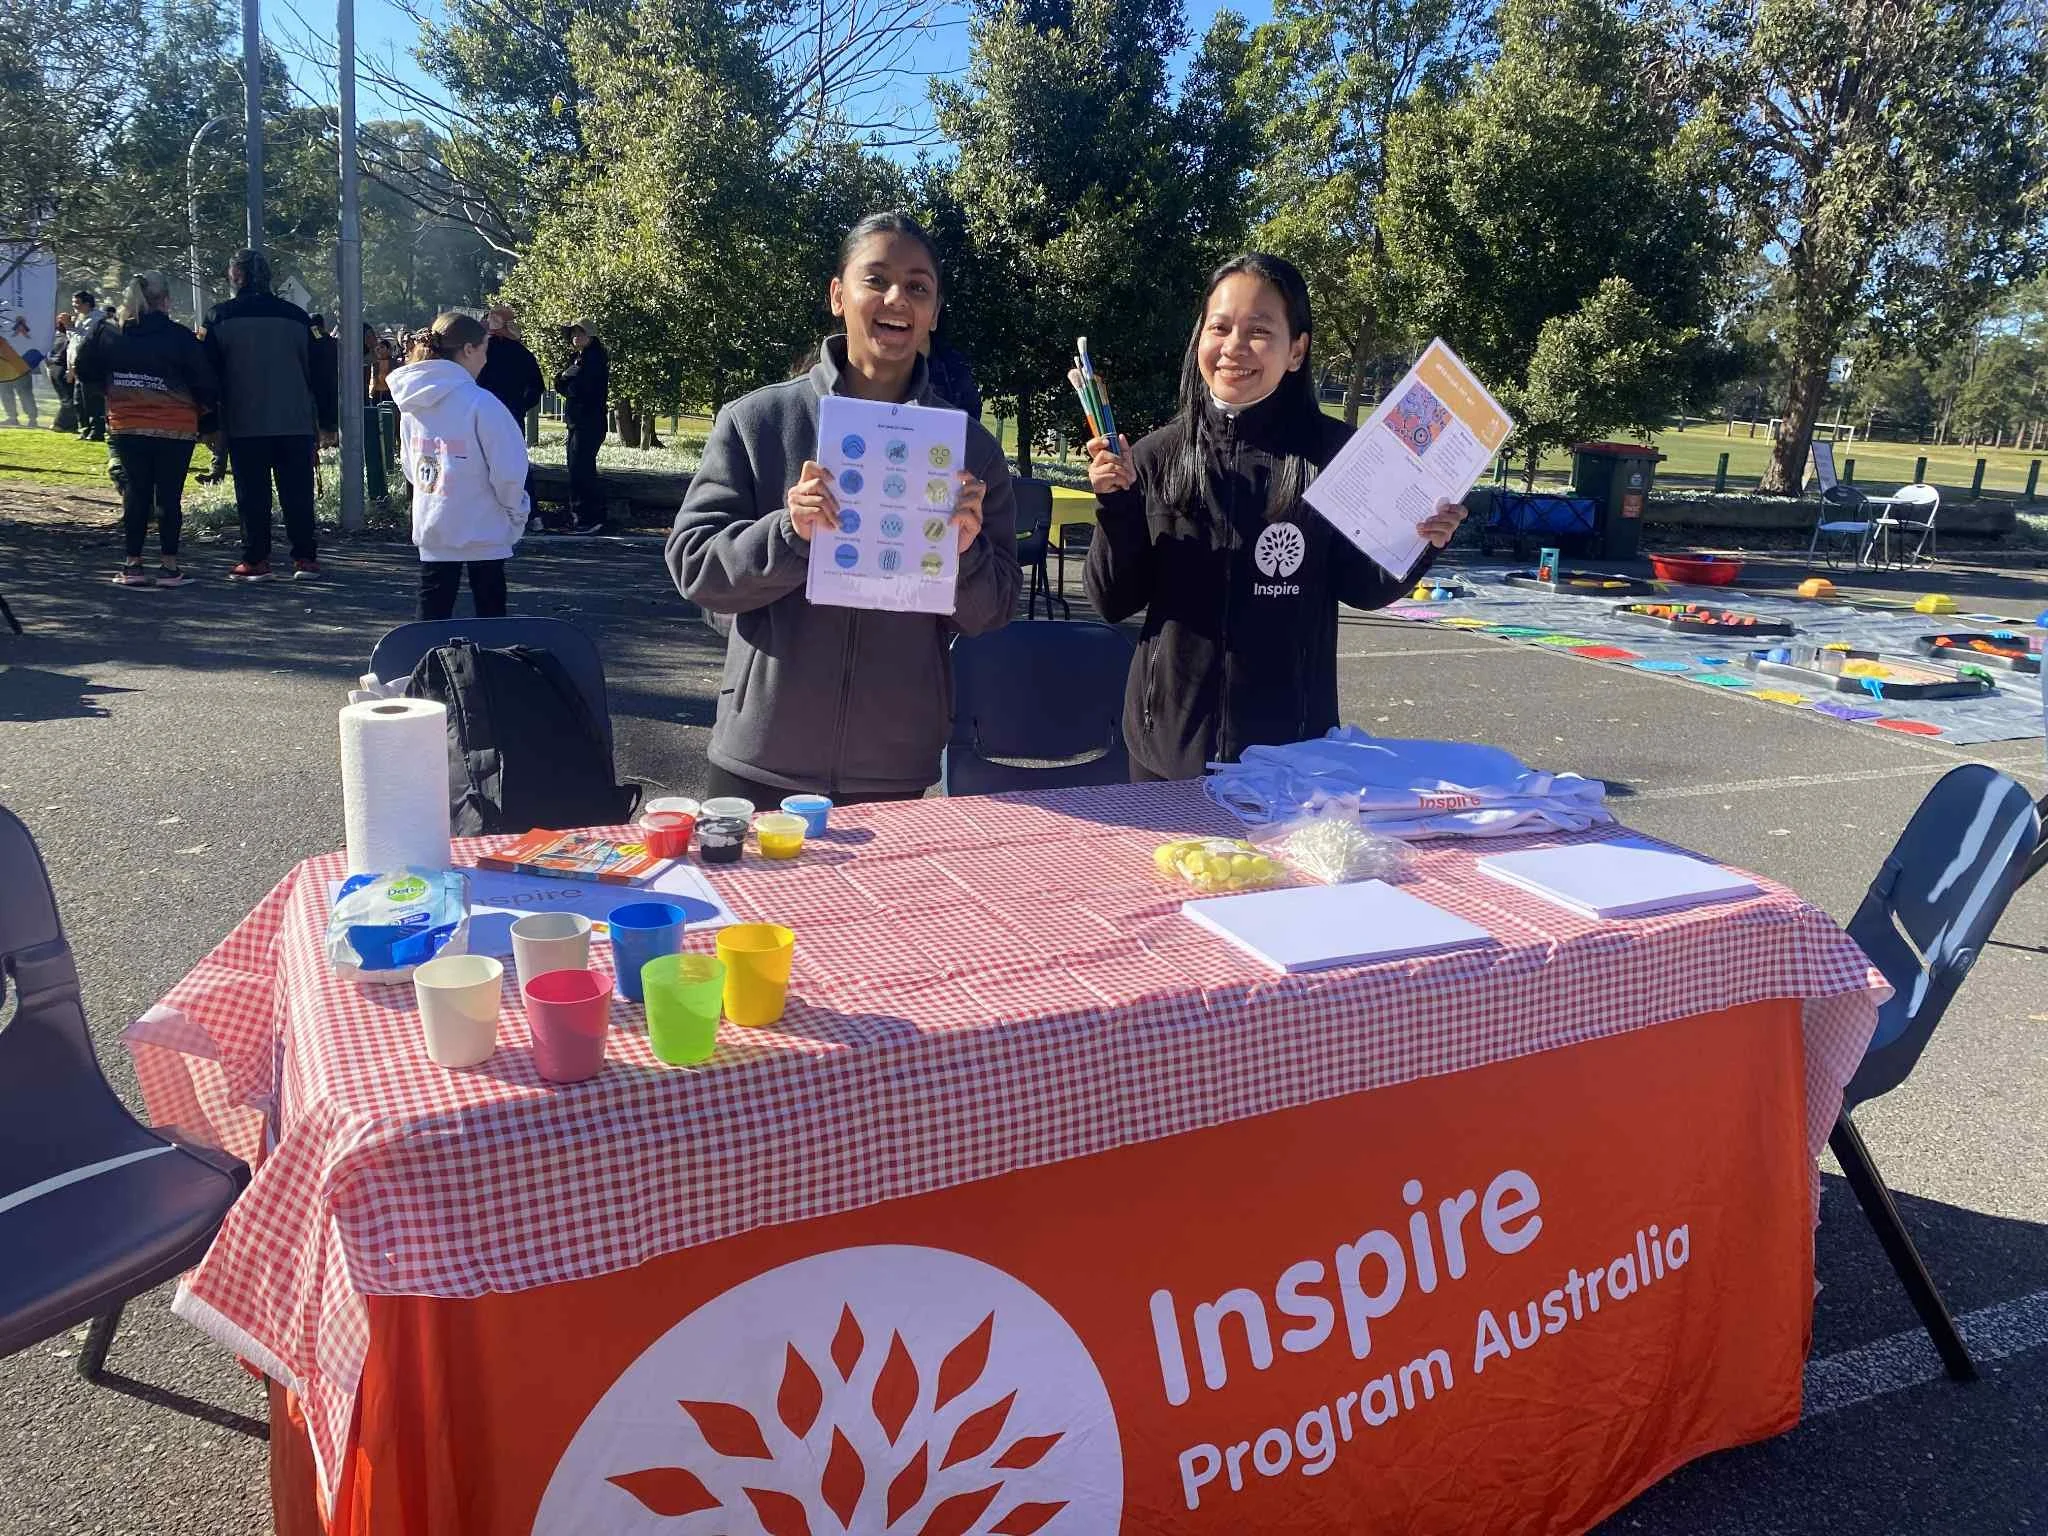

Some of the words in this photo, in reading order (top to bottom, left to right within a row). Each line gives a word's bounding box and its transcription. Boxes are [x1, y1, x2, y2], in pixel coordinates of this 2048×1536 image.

[1254, 582, 1300, 598] Inspire
[1149, 1169, 1544, 1407] Inspire
[1178, 1348, 1455, 1511] Program
[1472, 1222, 1692, 1374] Australia
